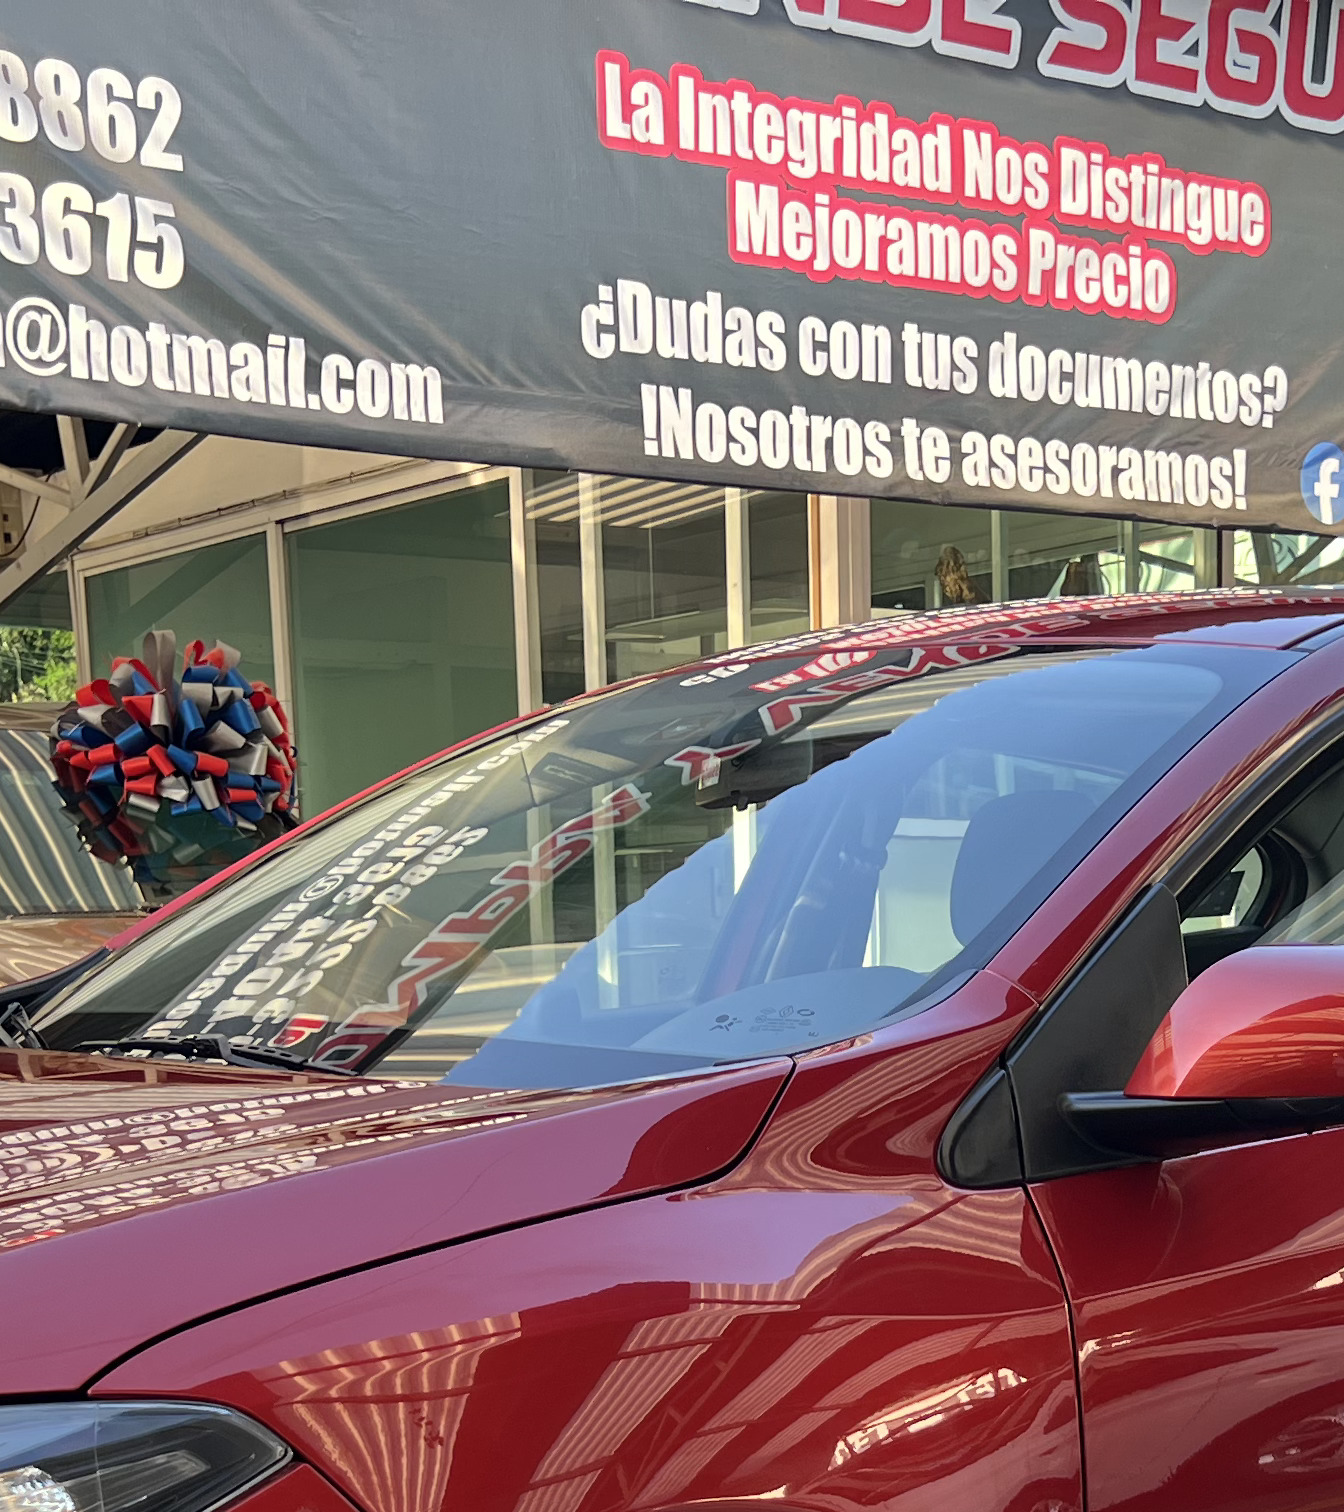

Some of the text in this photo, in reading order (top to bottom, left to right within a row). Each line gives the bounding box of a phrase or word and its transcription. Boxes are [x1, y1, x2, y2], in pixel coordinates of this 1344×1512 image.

[604, 61, 1266, 248] La Integridad Nos Distingue
[735, 179, 1171, 315] Mejoramos Precio
[579, 278, 1289, 429] ¿Dudas con tus documentos?
[900, 417, 951, 485] te
[960, 431, 1248, 512] asesoramos!
